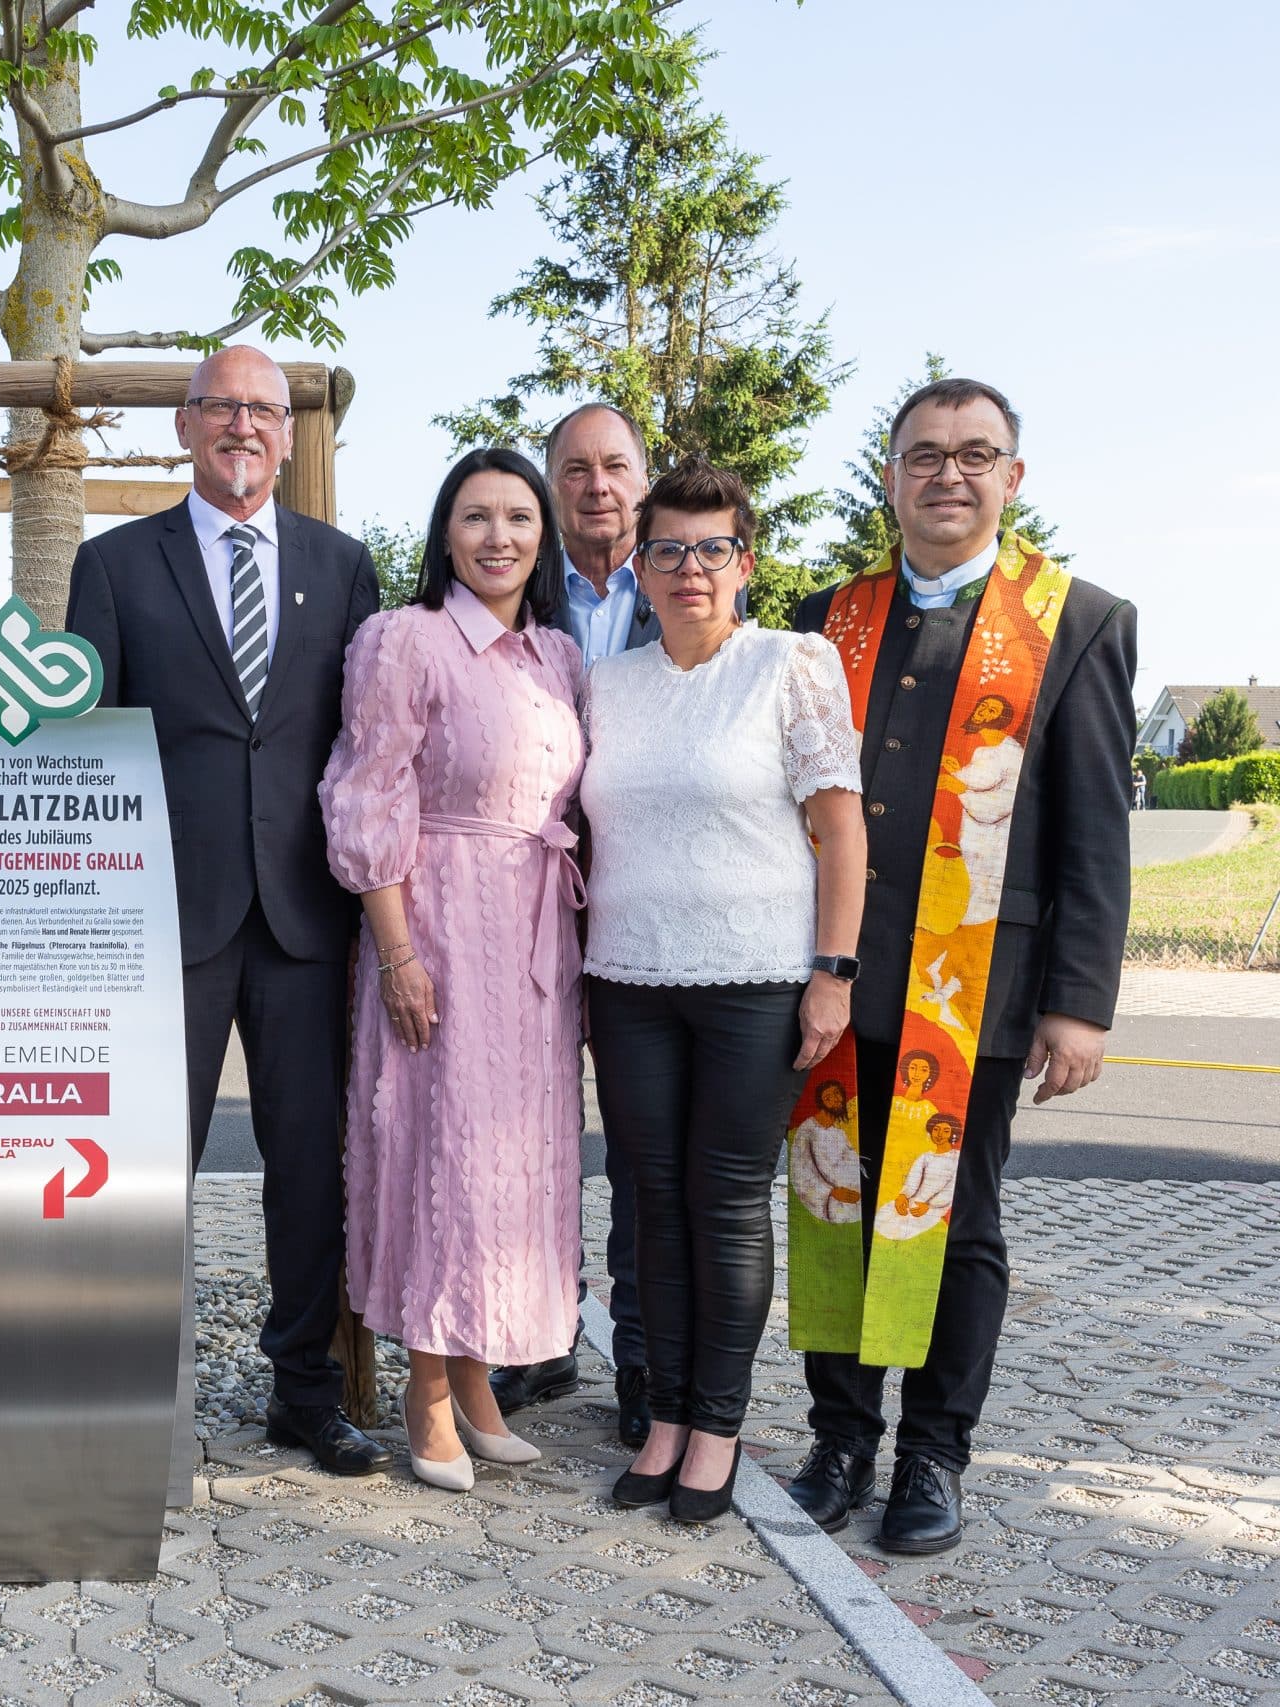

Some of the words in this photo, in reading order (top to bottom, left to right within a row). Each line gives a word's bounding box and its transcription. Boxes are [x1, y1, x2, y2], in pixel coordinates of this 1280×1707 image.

[10, 754, 32, 769] von
[37, 754, 103, 769] Wachstum
[32, 771, 72, 786] wurde
[77, 771, 116, 786] dieser
[0, 829, 21, 846] des
[26, 829, 92, 846] Jubiläums
[87, 851, 144, 870] GRALLA
[0, 878, 29, 896] 2025
[34, 878, 100, 898] gepflanzt.
[108, 906, 119, 915] Zeit
[122, 907, 143, 915] unserer
[1, 917, 24, 926] dienen.
[26, 917, 37, 926] Aus
[84, 918, 93, 926] zu
[94, 917, 111, 926] Gralla
[113, 917, 131, 926] sowie
[132, 917, 143, 926] den
[9, 928, 20, 936] von
[42, 927, 56, 936] Hans
[57, 927, 68, 936] und
[70, 927, 89, 936] Renate
[91, 927, 110, 936] Hierzer
[112, 927, 144, 937] gesponsert.
[49, 941, 86, 951] (Pterocarya
[134, 941, 144, 950] ein
[26, 951, 35, 960] der
[97, 951, 124, 960] heimisch
[126, 951, 132, 960] in
[133, 951, 144, 960] den
[79, 963, 89, 971] von
[91, 962, 100, 971] bis
[101, 963, 108, 971] zu
[119, 963, 125, 971] m
[19, 973, 36, 982] seine
[39, 973, 64, 983] großen,
[67, 973, 104, 983] goldgelben
[132, 973, 144, 982] und
[90, 984, 102, 993] und
[1, 1007, 30, 1017] UNSERE
[34, 1007, 91, 1017] GEMEINSCHAFT
[95, 1007, 110, 1017] UND
[9, 1020, 67, 1031] ZUSAMMENHALT
[70, 1020, 110, 1031] ERINNERN.
